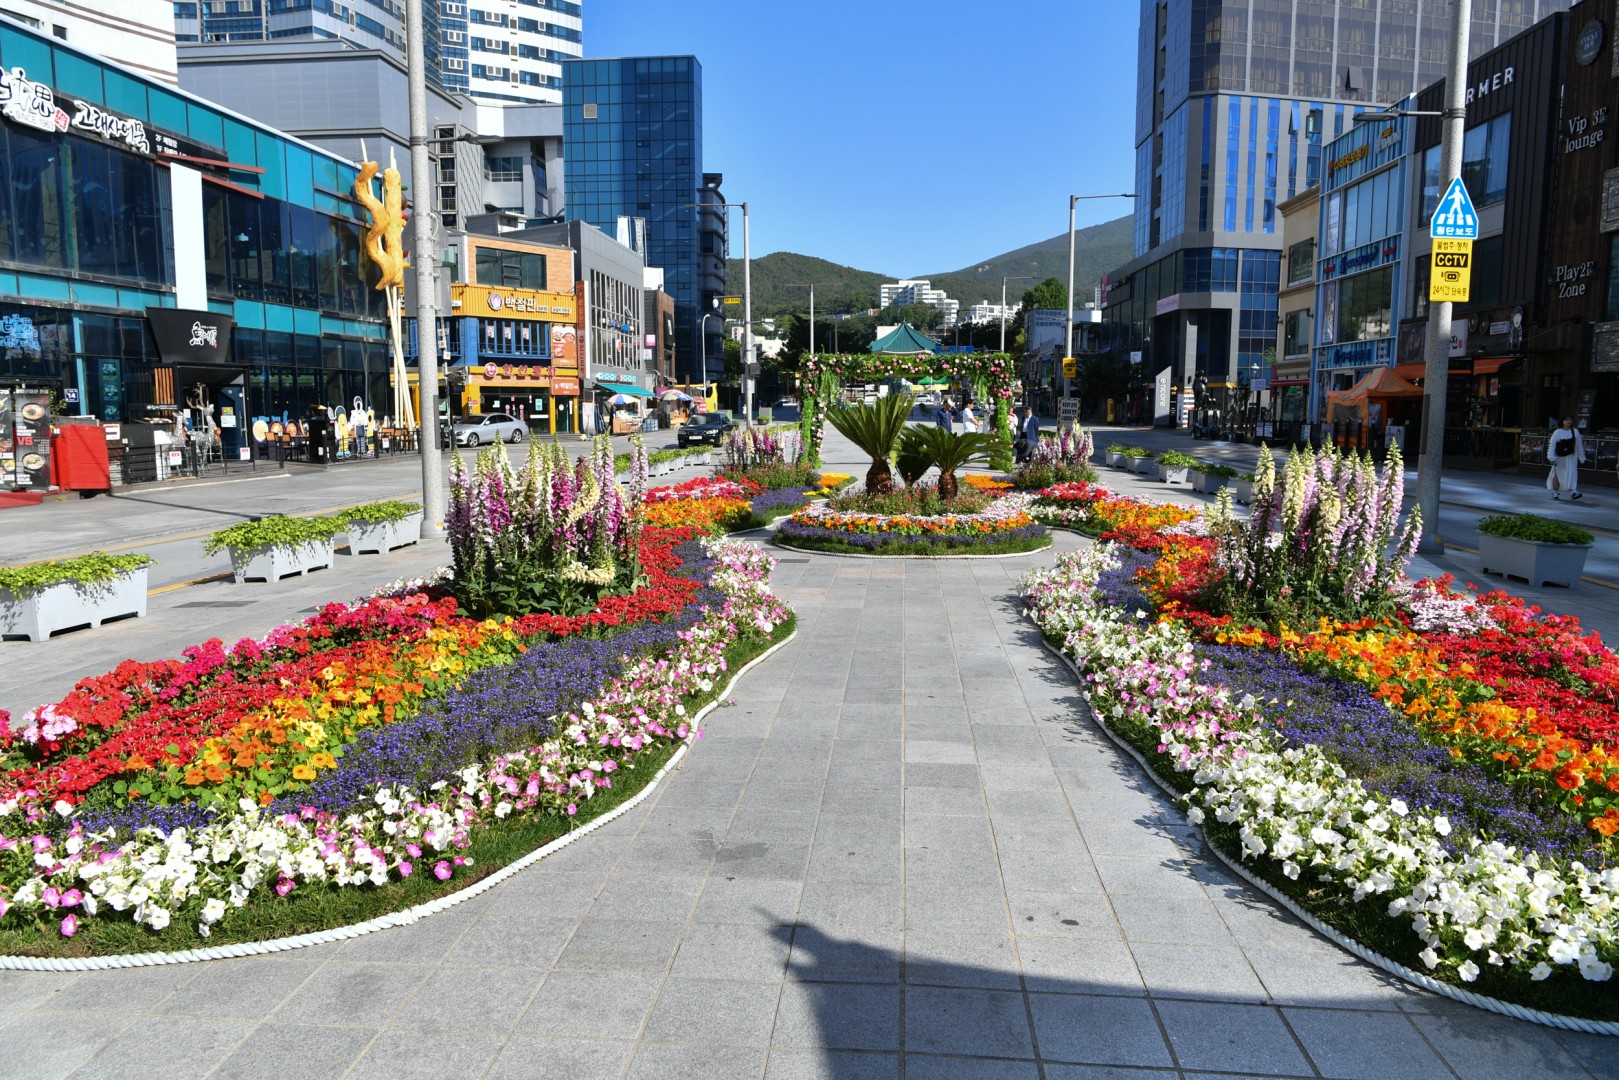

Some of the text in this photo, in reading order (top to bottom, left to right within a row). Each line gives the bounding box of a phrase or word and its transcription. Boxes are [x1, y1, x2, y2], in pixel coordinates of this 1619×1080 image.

[16, 110, 37, 124] SINCE
[39, 118, 54, 130] 1963
[72, 101, 149, 154] 고래사어묵
[1568, 115, 1587, 134] Vip
[1565, 129, 1604, 153] lounge
[1436, 226, 1474, 236] 횡단보도
[1436, 254, 1466, 266] CCTV
[1556, 264, 1581, 281] Play
[1432, 285, 1450, 295] 24시간
[1559, 283, 1586, 298] Zone
[505, 295, 536, 312] 백철판
[17, 436, 33, 446] VS
